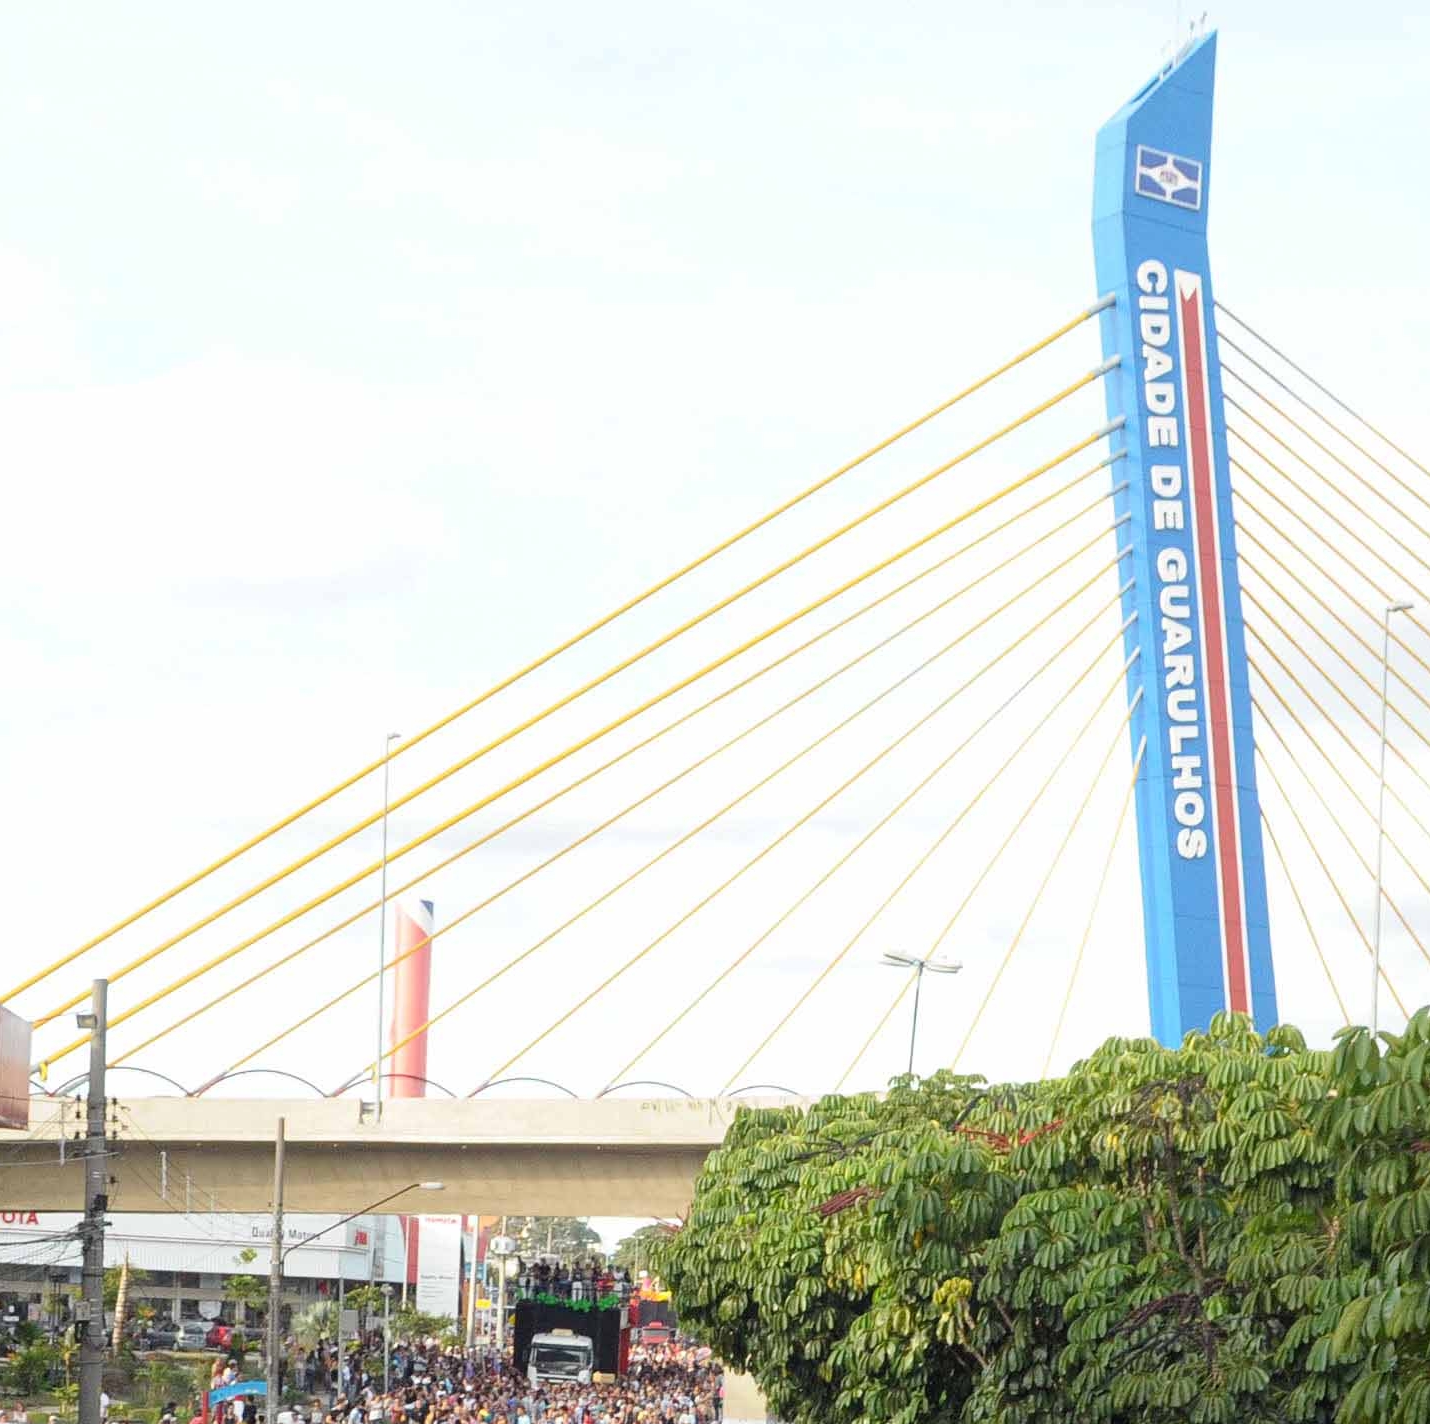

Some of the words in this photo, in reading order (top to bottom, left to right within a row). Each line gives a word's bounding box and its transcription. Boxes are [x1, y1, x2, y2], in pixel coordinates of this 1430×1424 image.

[1136, 259, 1179, 449] CIDADE
[1150, 464, 1184, 531] DE
[1156, 547, 1208, 861] GUARULHOS
